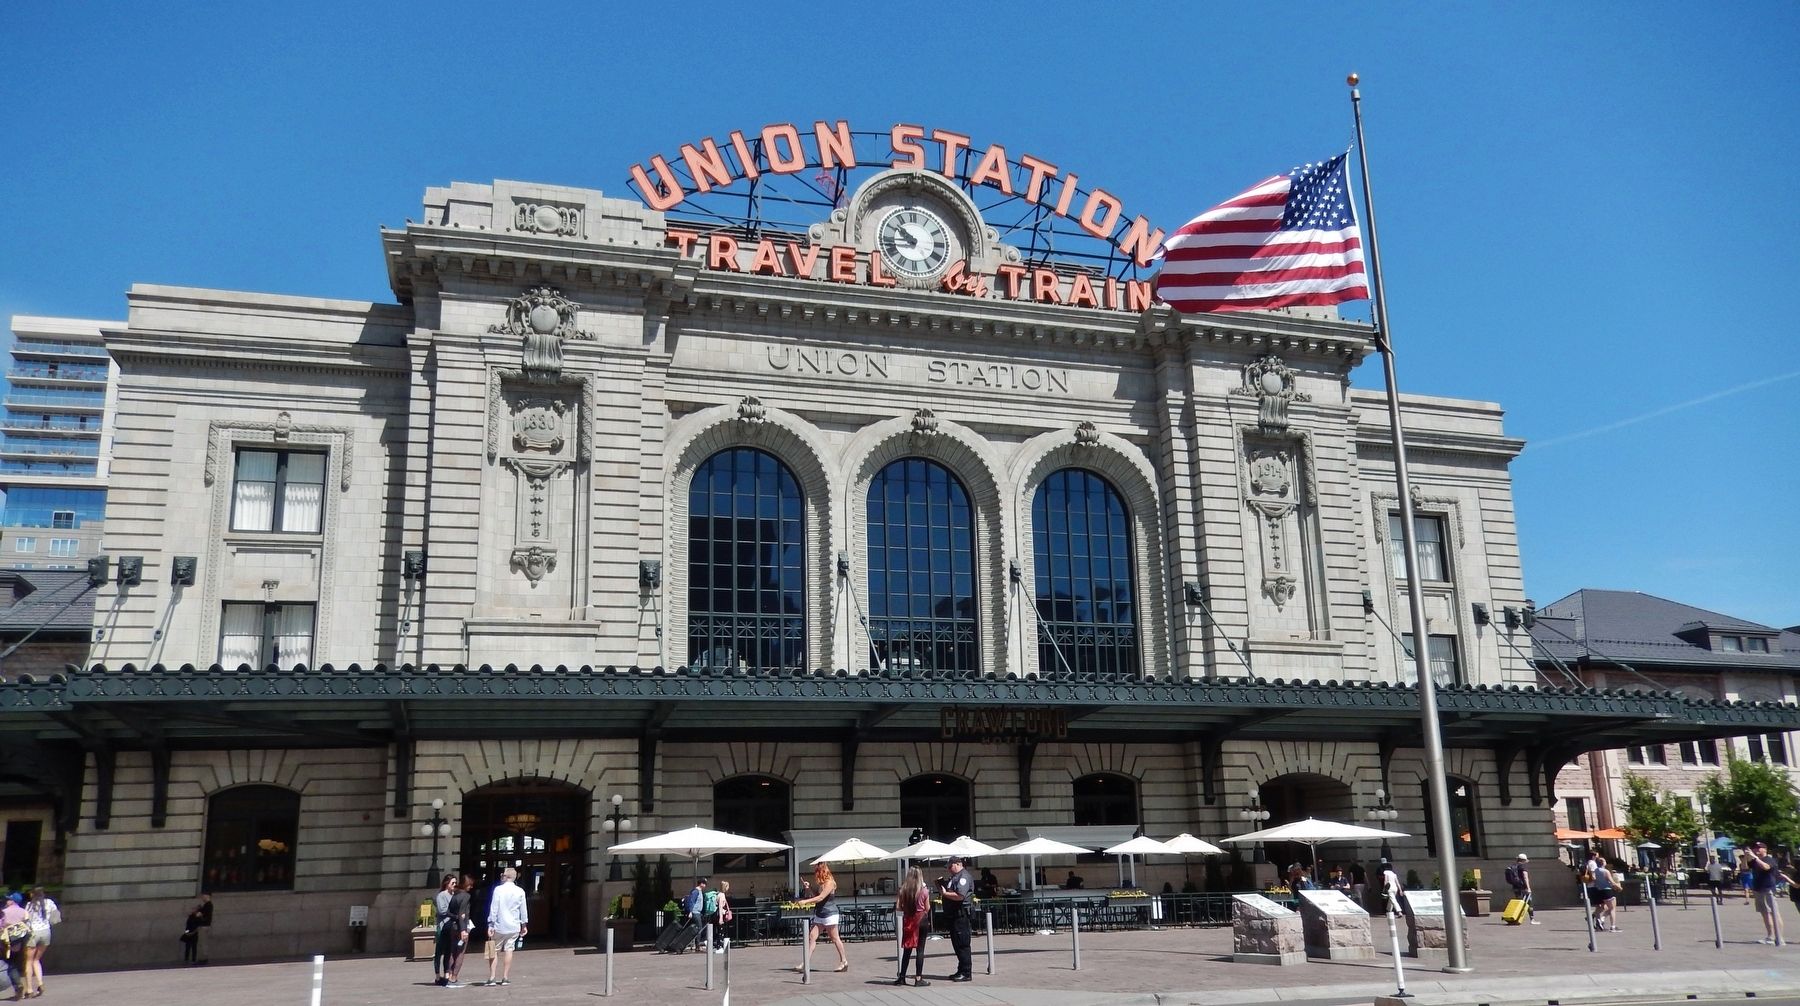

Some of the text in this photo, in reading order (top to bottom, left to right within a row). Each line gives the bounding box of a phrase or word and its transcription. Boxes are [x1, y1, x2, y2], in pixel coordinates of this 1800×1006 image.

[630, 120, 1166, 268] UNION STATION
[667, 230, 1152, 311] TRAVEL by TRAIN
[766, 346, 1069, 393] UNION STATION
[941, 706, 1068, 738] CRAWFORD
[982, 736, 1031, 745] HOTEL
